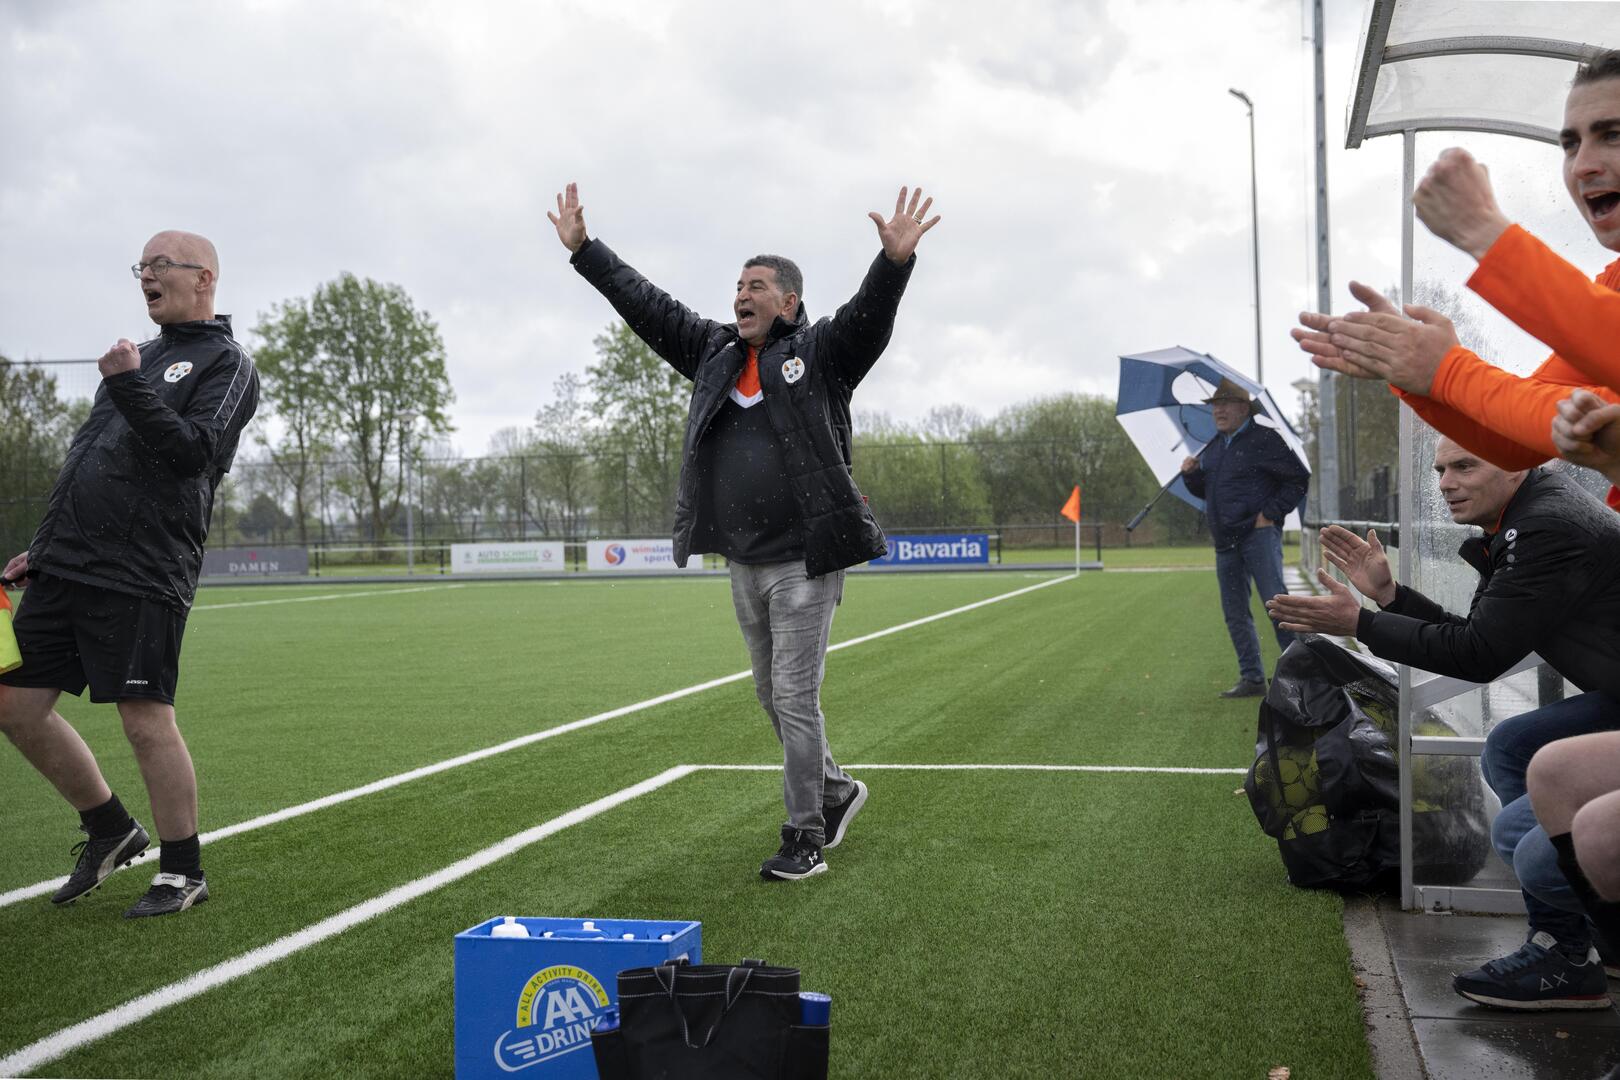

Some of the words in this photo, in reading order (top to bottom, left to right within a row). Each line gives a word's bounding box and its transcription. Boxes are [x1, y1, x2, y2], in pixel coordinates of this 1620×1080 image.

[644, 555, 671, 564] sport
[897, 538, 981, 560] Bavaria
[229, 561, 279, 573] DAMEN
[520, 992, 533, 1013] ALL
[532, 967, 573, 990] ACTIVITY
[576, 970, 604, 995] DRINK
[543, 986, 595, 1031] AA
